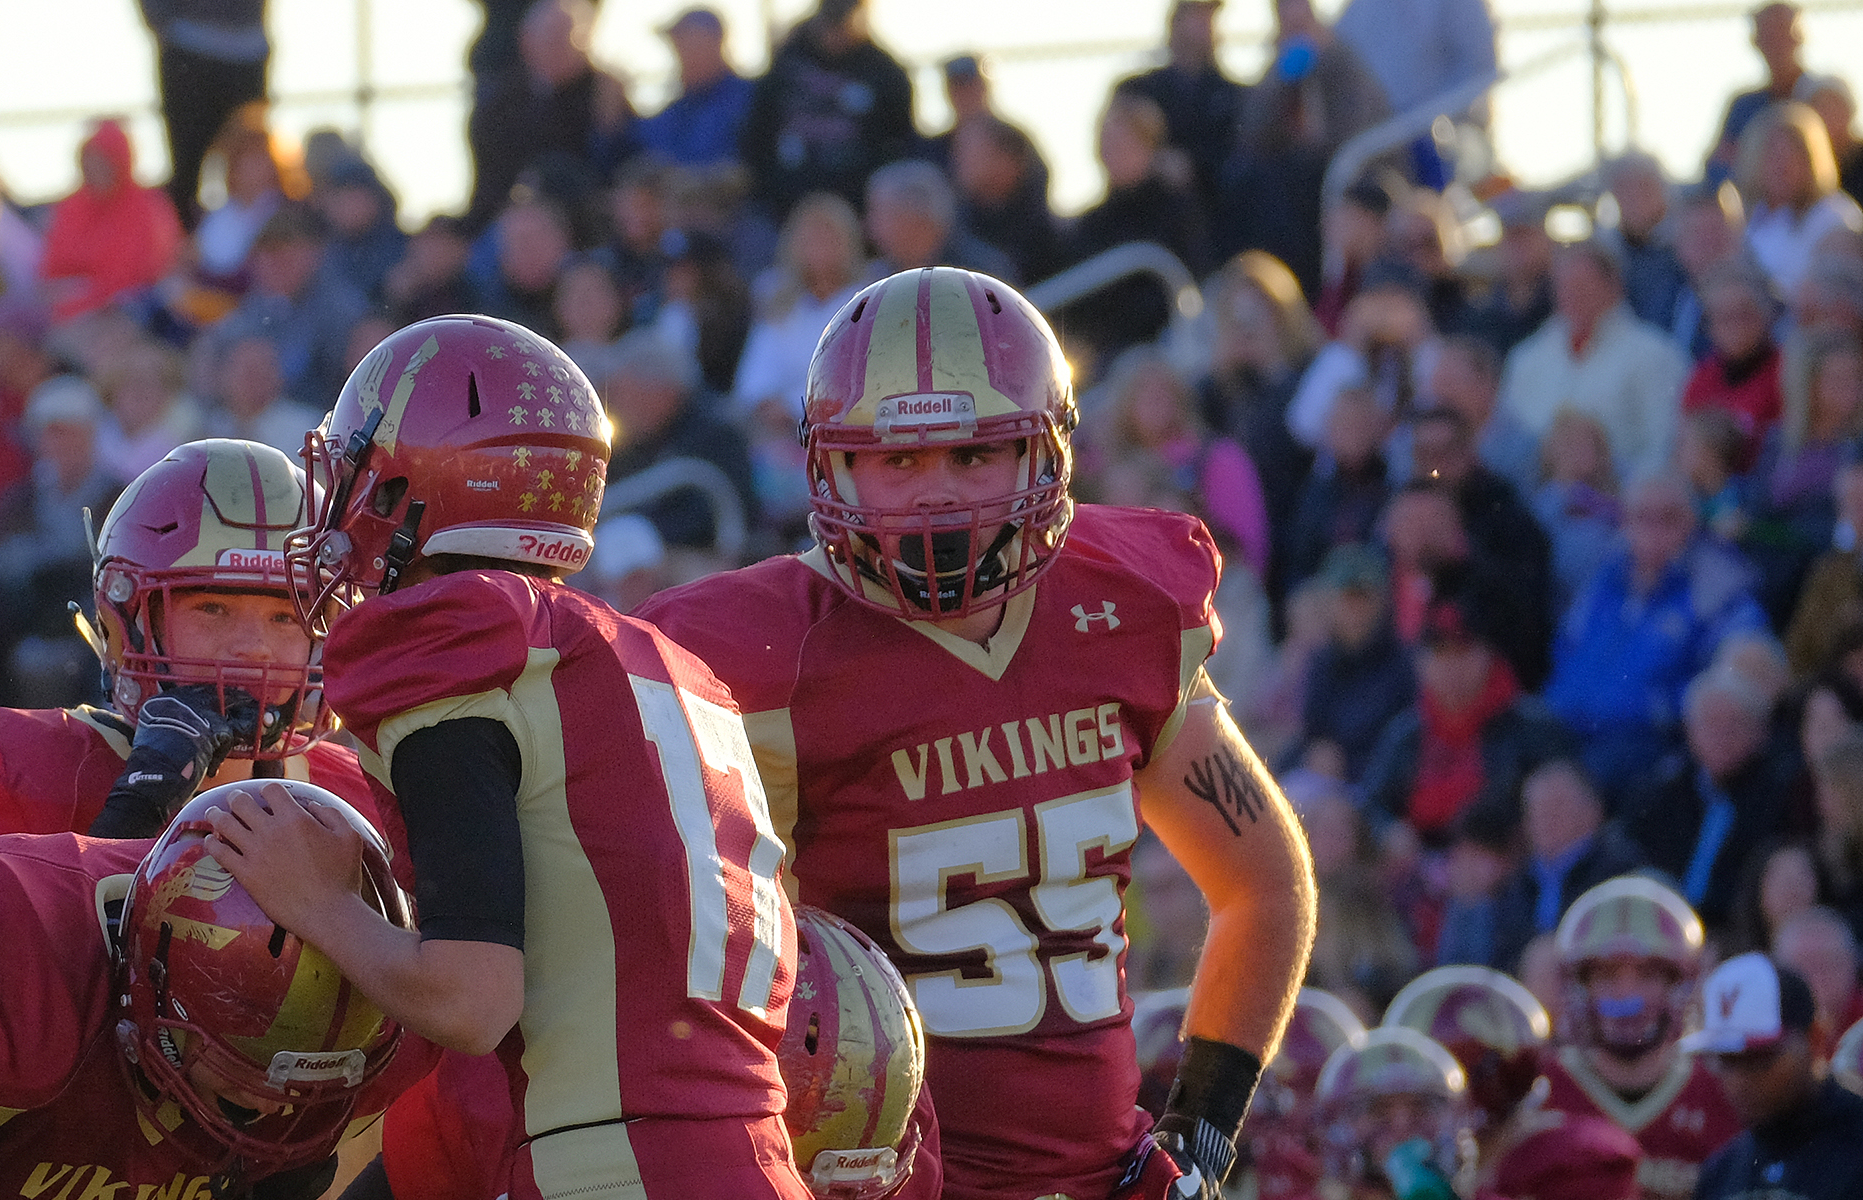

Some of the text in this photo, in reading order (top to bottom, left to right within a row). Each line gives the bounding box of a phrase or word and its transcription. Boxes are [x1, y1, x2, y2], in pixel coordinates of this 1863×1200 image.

[898, 398, 951, 414] Riddell
[466, 479, 498, 488] Riddell
[229, 552, 284, 568] Ridde
[890, 702, 1125, 801] VIKINGS
[128, 770, 163, 785] CUTTERS
[888, 777, 1139, 1038] 55
[294, 1056, 347, 1070] Riddell
